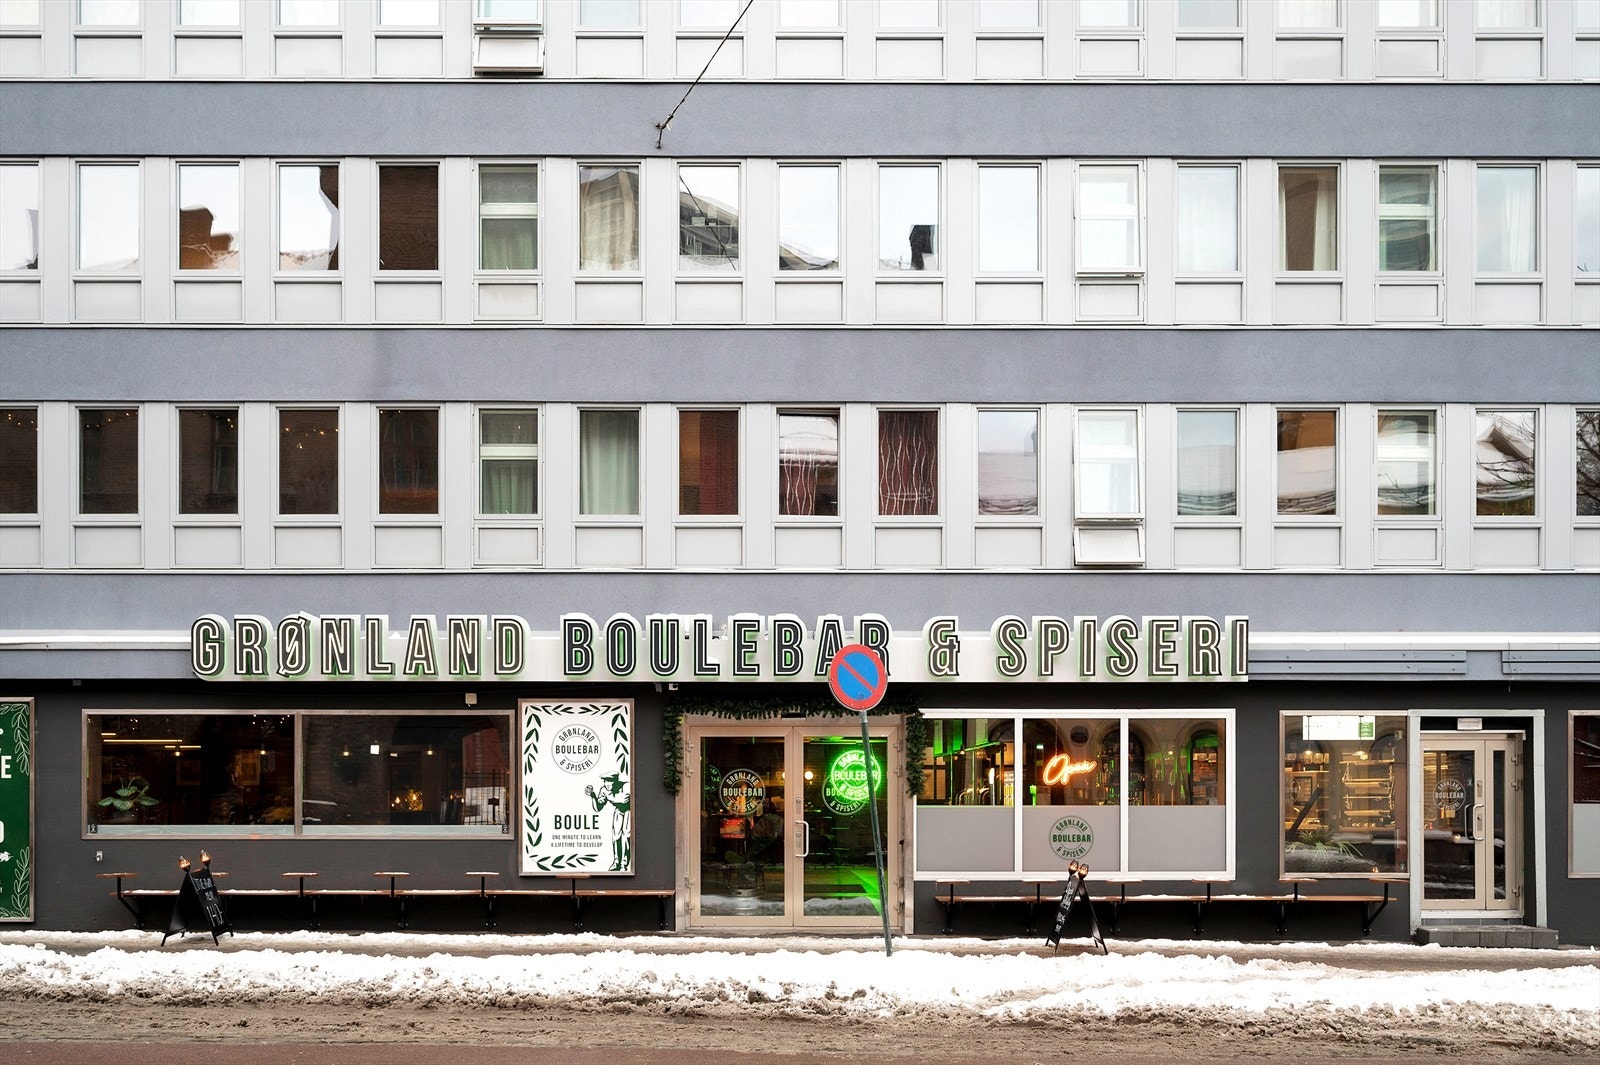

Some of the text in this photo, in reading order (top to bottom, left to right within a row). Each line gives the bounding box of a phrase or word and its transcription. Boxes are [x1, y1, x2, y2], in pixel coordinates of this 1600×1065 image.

[191, 616, 525, 677] GRØNLAND
[929, 619, 960, 677] &
[996, 619, 1249, 677] SPISERI
[558, 727, 596, 742] GRØNLAND
[555, 744, 599, 755] BOULEBAR
[565, 758, 593, 772] SPISERI
[1043, 754, 1097, 786] Open
[726, 771, 760, 786] GRØNLAND
[834, 770, 879, 781] BOULEBR
[723, 787, 763, 797] BOULEBAR
[836, 800, 861, 812] SPISERI
[554, 814, 600, 830] BOULE
[1056, 819, 1088, 832] GRØNLAND
[1052, 834, 1092, 843] BOULEBAR
[1062, 847, 1086, 858] SPISERI
